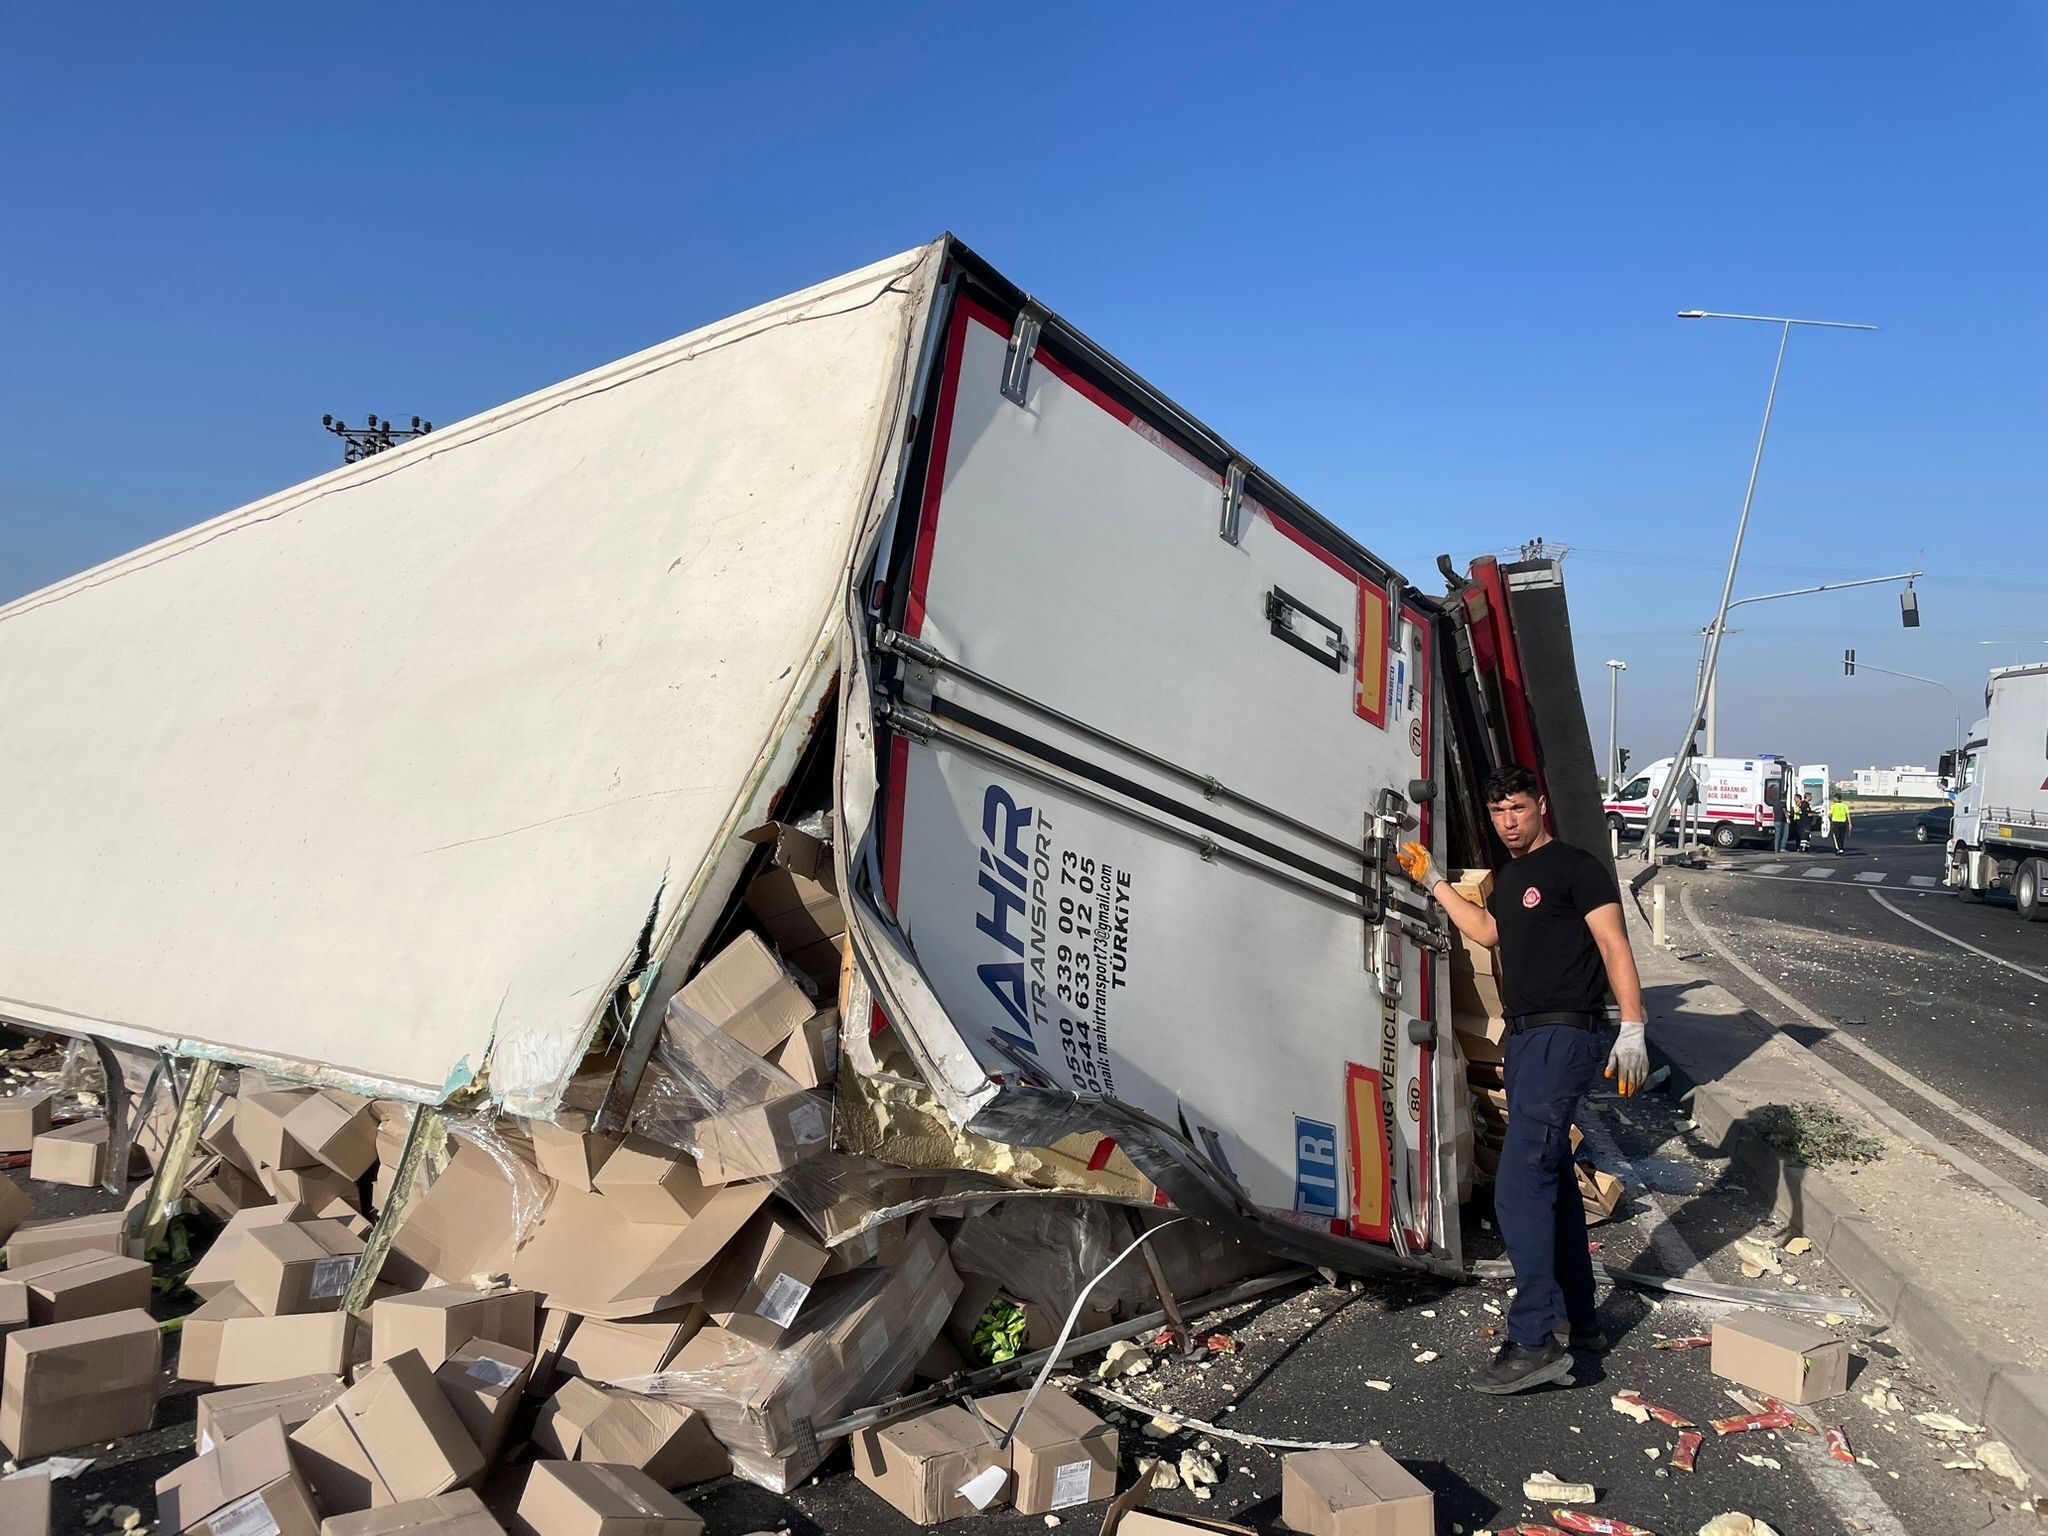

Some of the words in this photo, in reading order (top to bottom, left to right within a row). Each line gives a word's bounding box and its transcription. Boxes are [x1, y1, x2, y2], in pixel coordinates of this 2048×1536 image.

[1412, 726, 1421, 748] 70
[1060, 850, 1078, 887] 73
[1079, 856, 1095, 895] 05
[1028, 808, 1053, 1026] TRANSPORT
[1058, 896, 1074, 935] 00
[1076, 903, 1092, 940] 12
[1057, 944, 1073, 1002] 339
[1075, 952, 1090, 1011] 633
[1092, 863, 1113, 1055] mahirtransport73@gmail.com
[1059, 1018, 1087, 1090] 0530
[1076, 1021, 1102, 1094] 0544
[1382, 997, 1397, 1091] VEHICLE
[1411, 1086, 1420, 1112] 80
[1300, 1133, 1335, 1217] TIR
